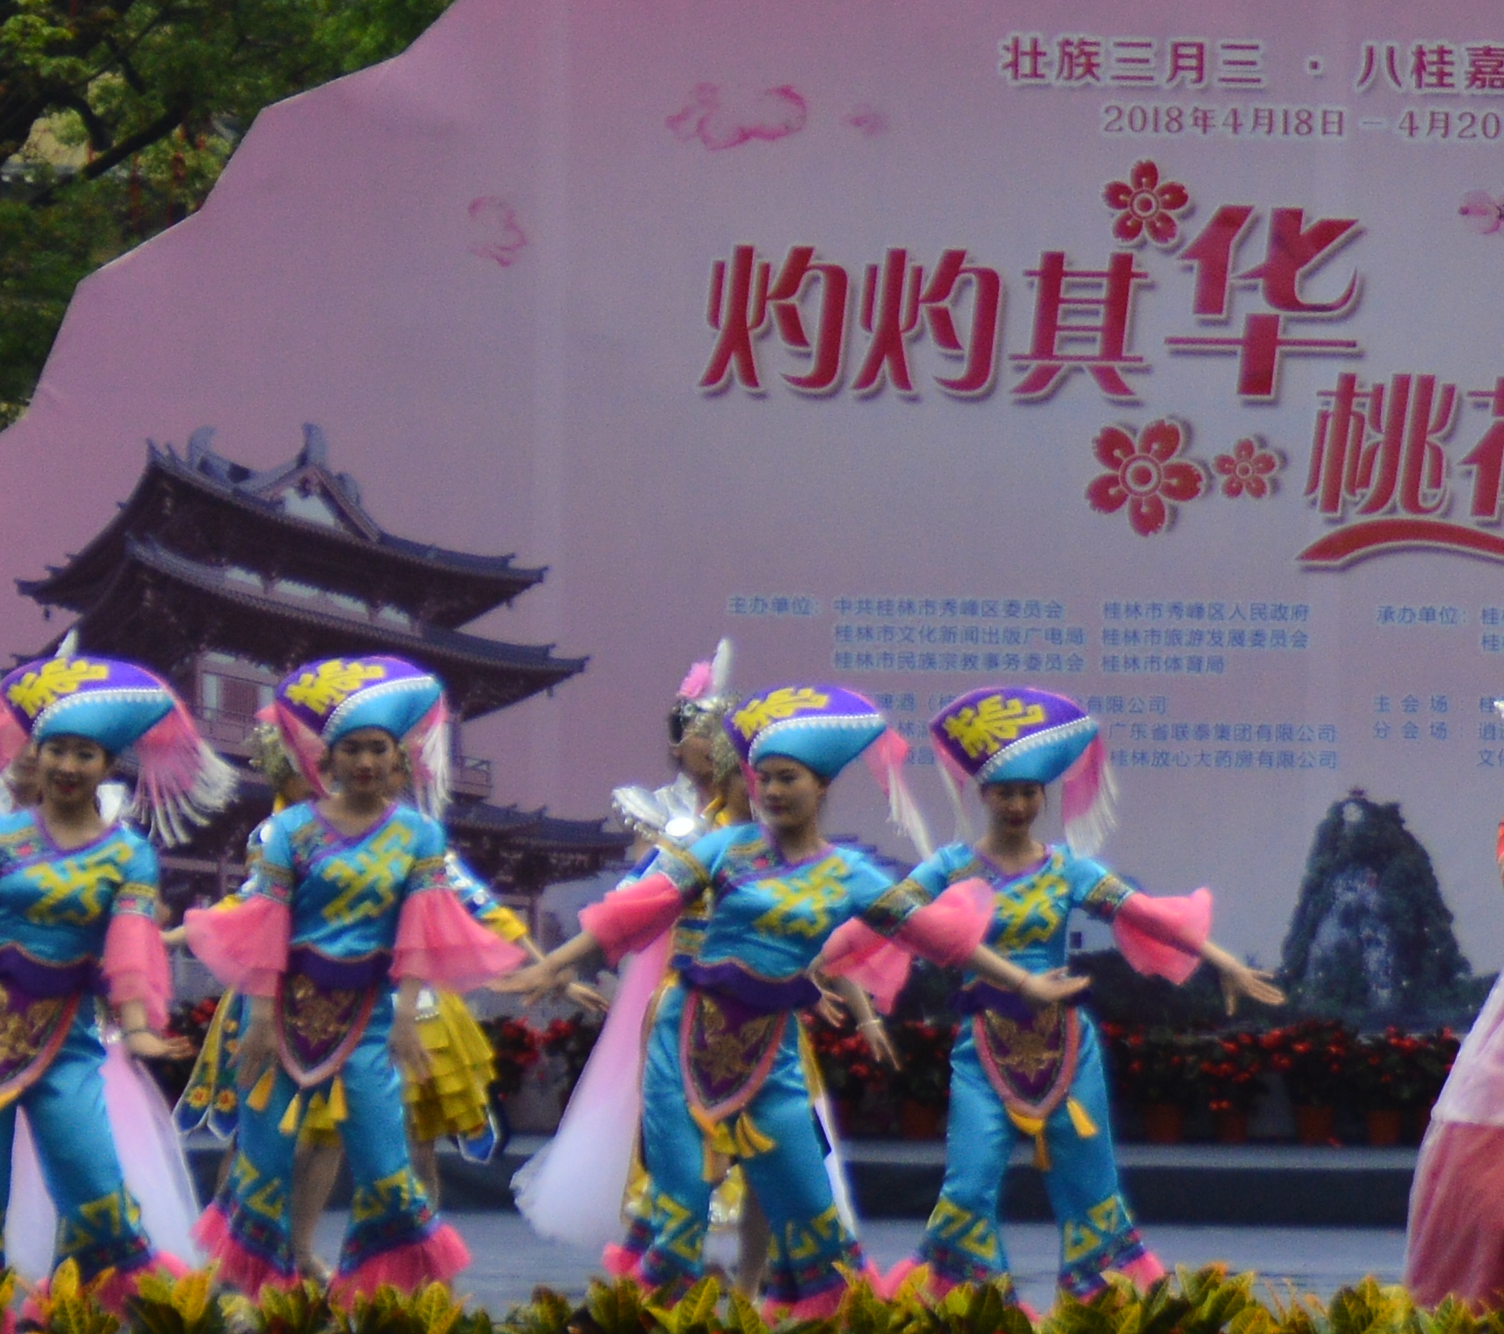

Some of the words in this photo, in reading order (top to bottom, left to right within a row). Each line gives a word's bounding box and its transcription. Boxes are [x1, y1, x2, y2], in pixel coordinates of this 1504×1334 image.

[698, 204, 1360, 399] 灼灼其华
[834, 597, 1064, 618] 中共桂林市秀峰区委员会
[1103, 601, 1310, 622] 桂林市秀峰区人民政府
[834, 624, 1086, 645] 桂林市文化新闻出版广电局
[1102, 627, 1310, 649] 桂林市旅游发展委员会
[1101, 654, 1226, 674] 桂林市体育局
